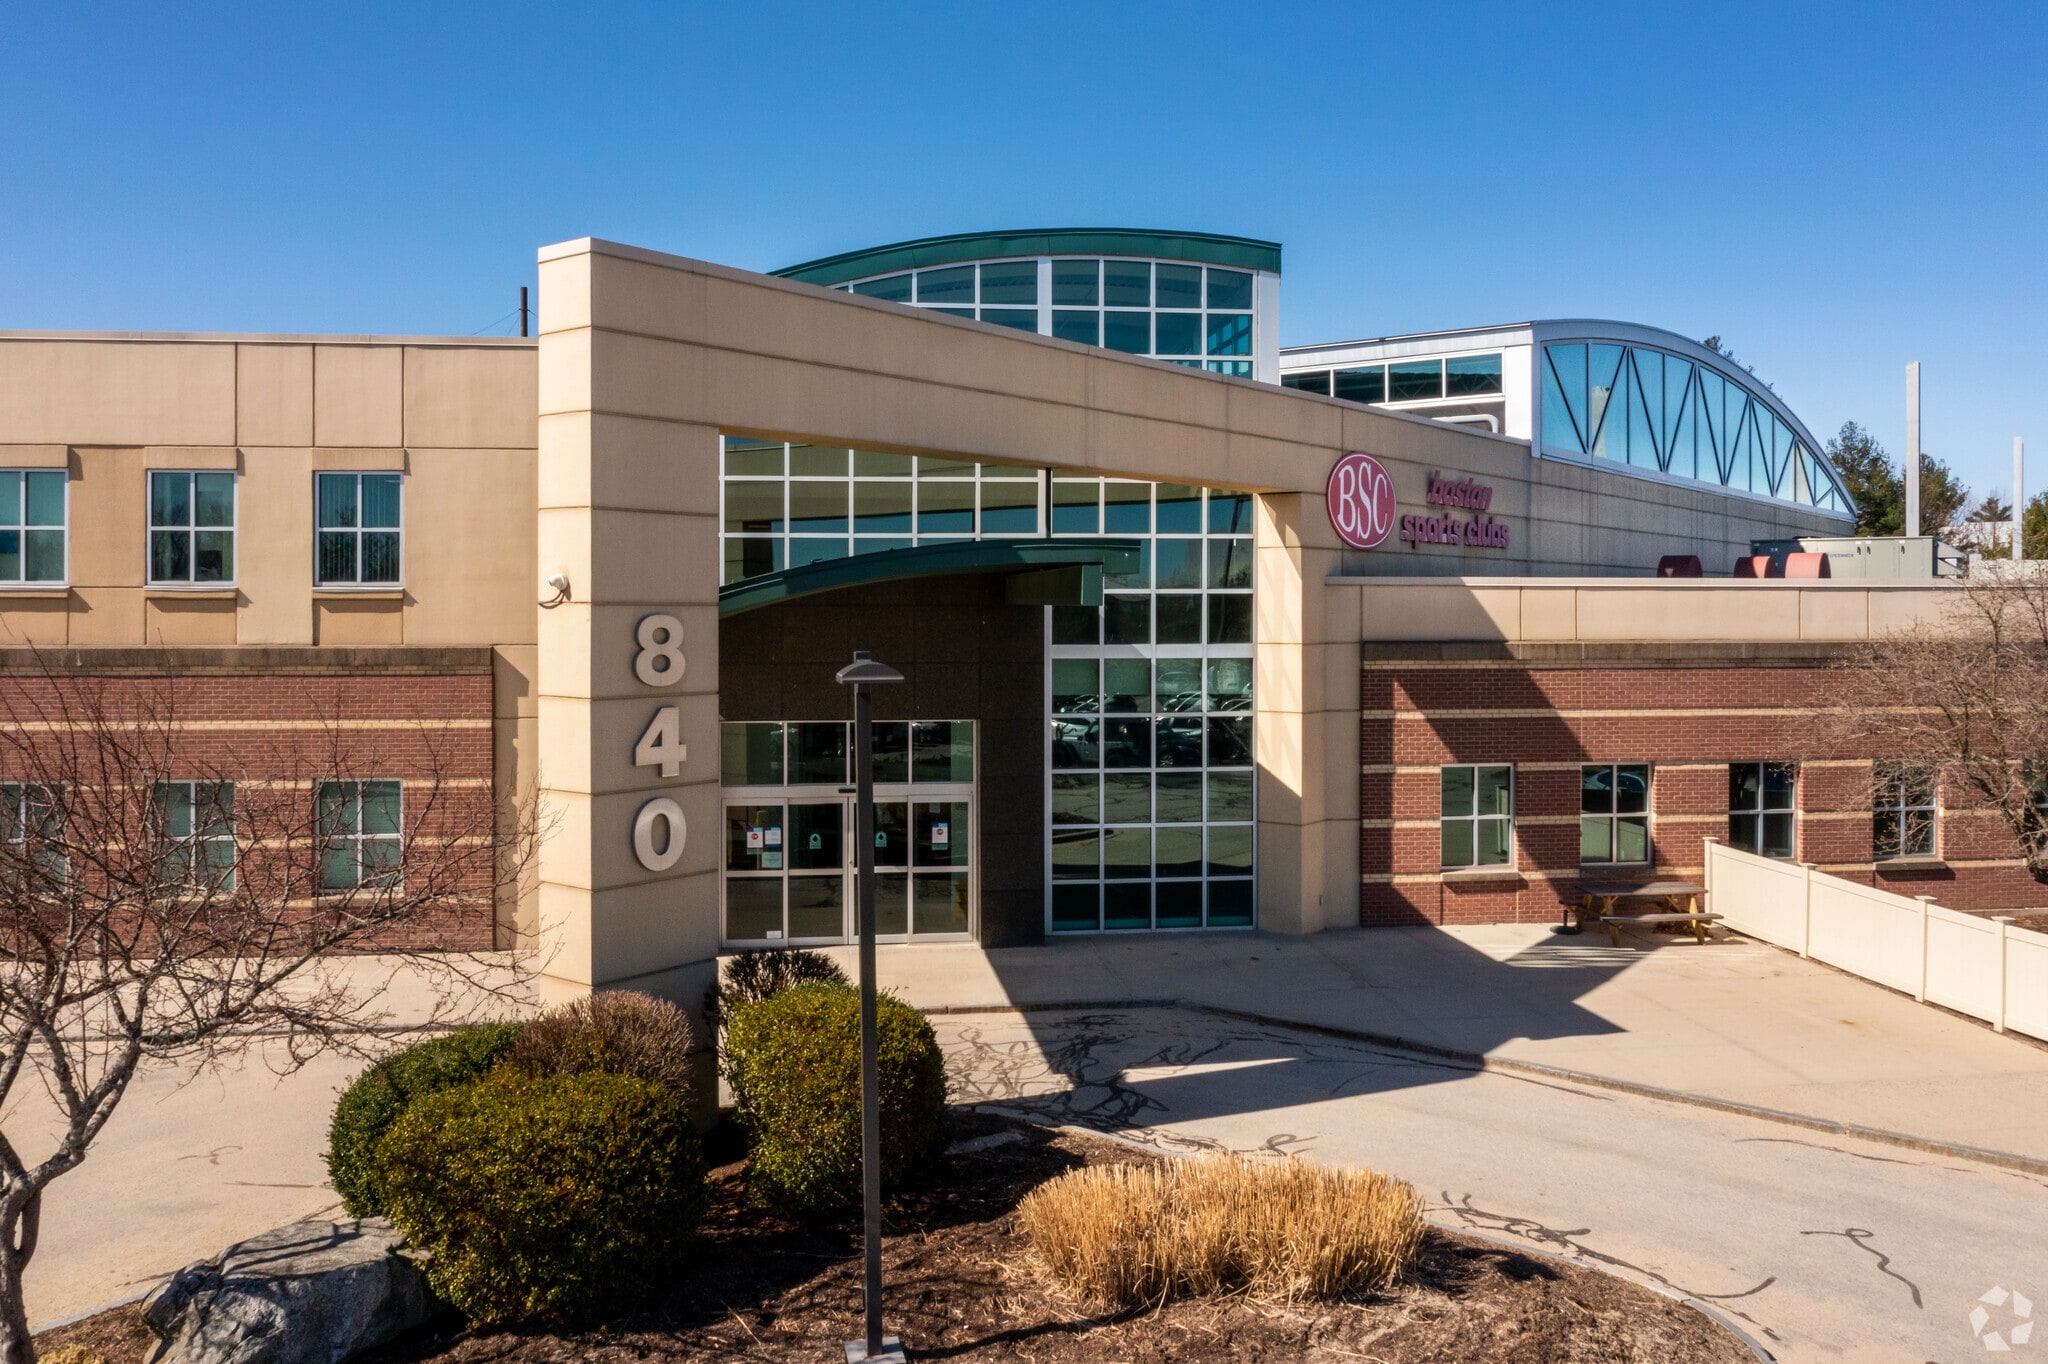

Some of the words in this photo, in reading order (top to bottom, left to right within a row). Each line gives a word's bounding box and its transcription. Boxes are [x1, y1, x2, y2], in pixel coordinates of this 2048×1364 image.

[1337, 461, 1388, 540] BSC
[1428, 469, 1493, 511] boston
[1401, 512, 1463, 549] sports
[1466, 515, 1510, 548] clubs
